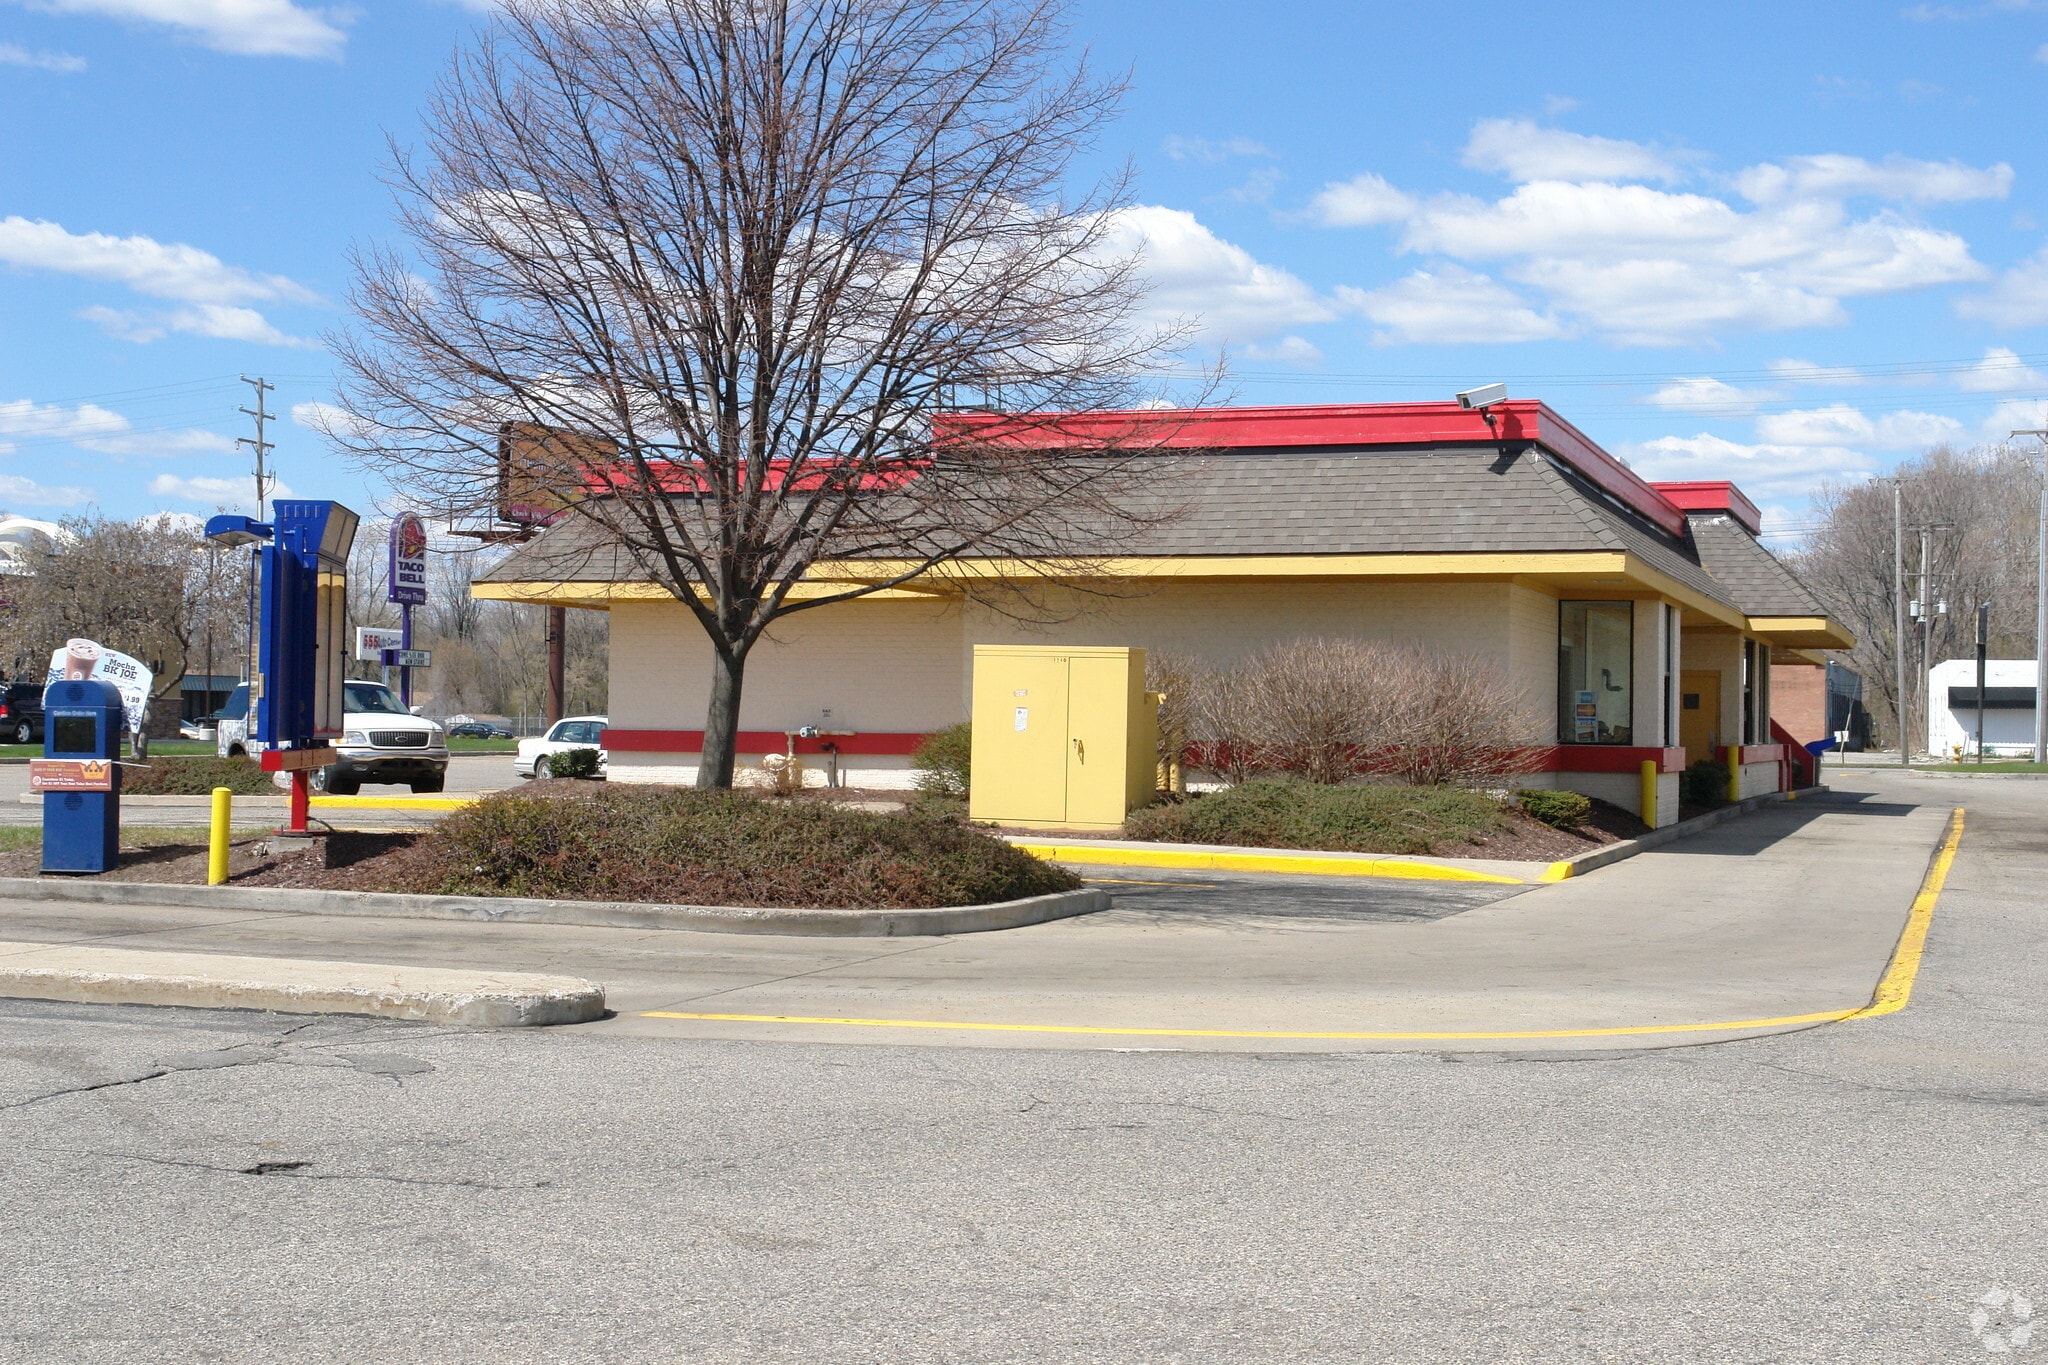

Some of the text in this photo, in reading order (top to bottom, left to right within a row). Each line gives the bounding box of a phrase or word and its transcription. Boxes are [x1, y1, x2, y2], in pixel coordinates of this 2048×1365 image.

[398, 561, 425, 572] TACO
[399, 572, 425, 584] BELL
[397, 591, 424, 601] Drive Thru
[363, 634, 379, 649] 555
[109, 658, 136, 671] Mocha
[103, 664, 119, 675] BK
[119, 668, 138, 680] JOE
